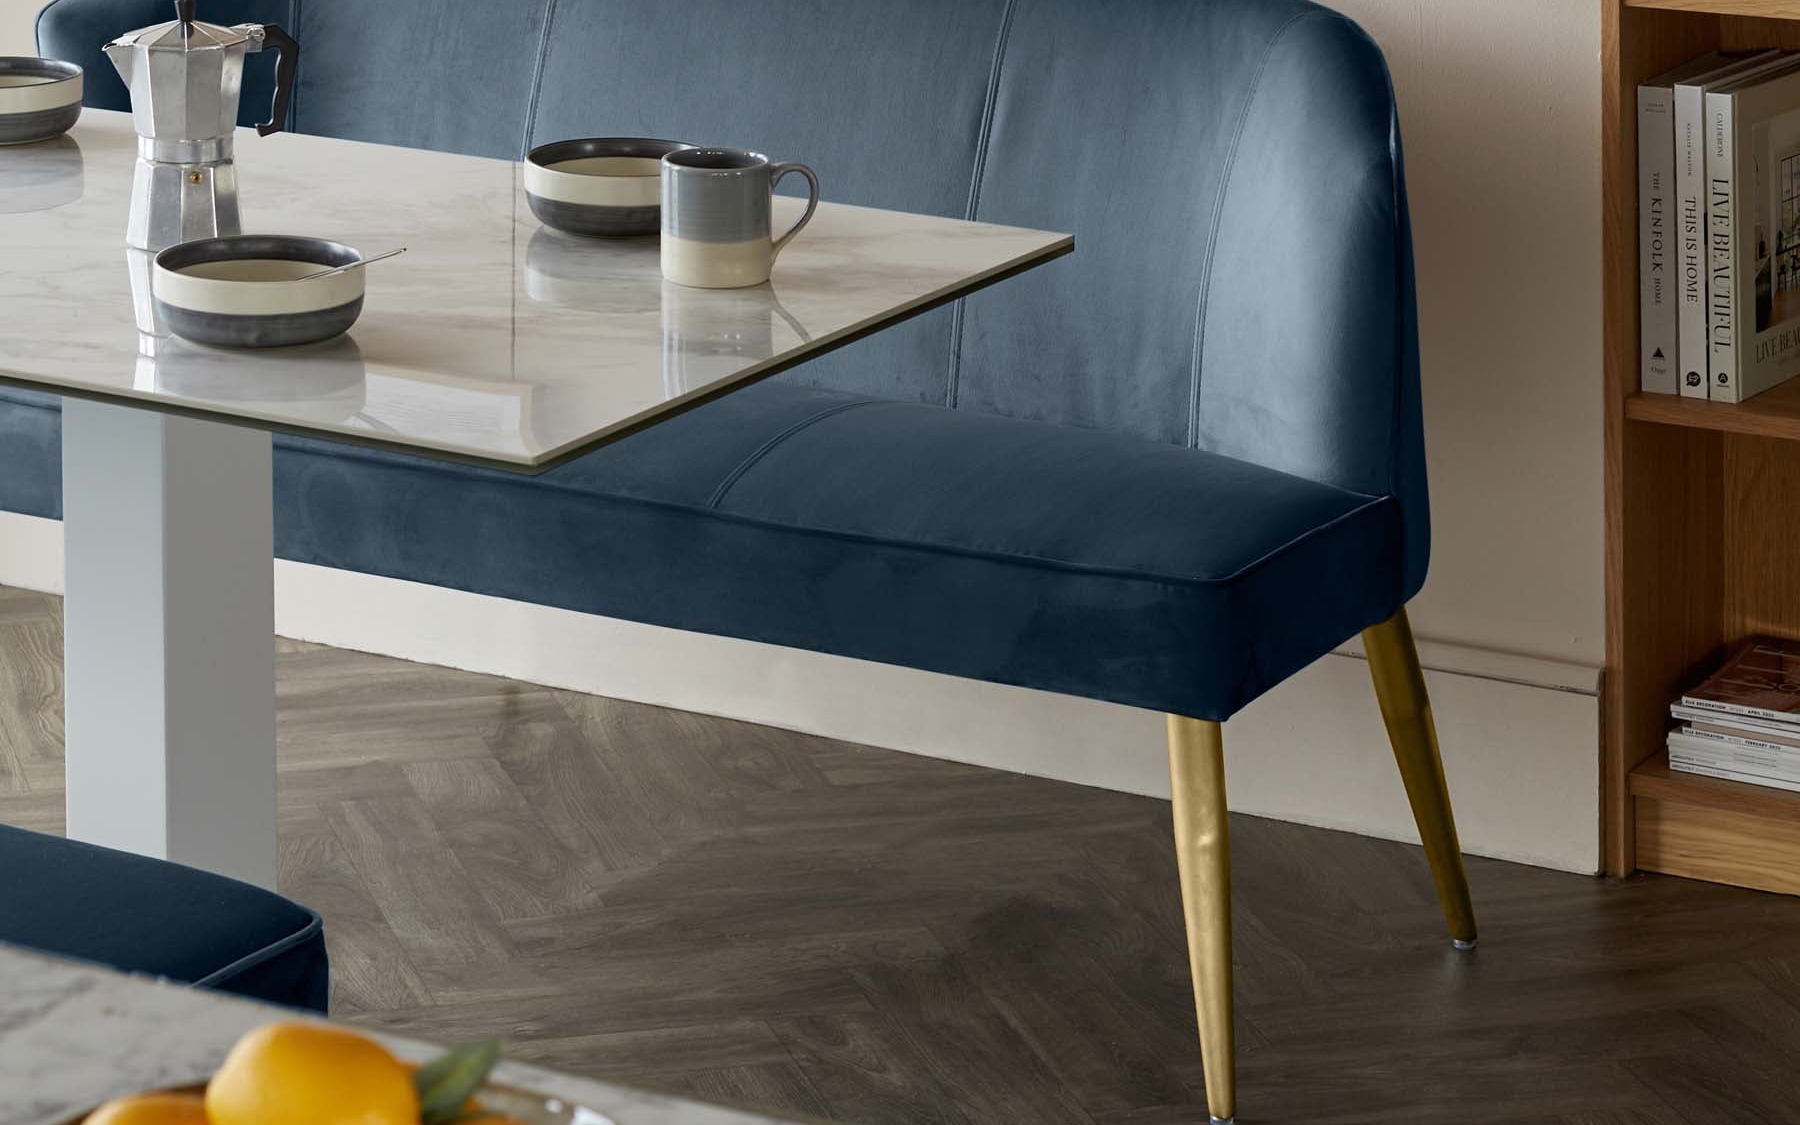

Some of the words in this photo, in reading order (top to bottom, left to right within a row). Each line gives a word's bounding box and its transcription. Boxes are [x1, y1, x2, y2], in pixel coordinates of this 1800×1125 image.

[1685, 196, 1697, 234] THIS
[1712, 178, 1730, 227] LIVE
[1651, 197, 1663, 271] KINFOLK
[1685, 237, 1697, 251] IS
[1654, 278, 1663, 305] HOME
[1686, 255, 1698, 303] HOME
[1713, 233, 1731, 353] BEAUTIFUL
